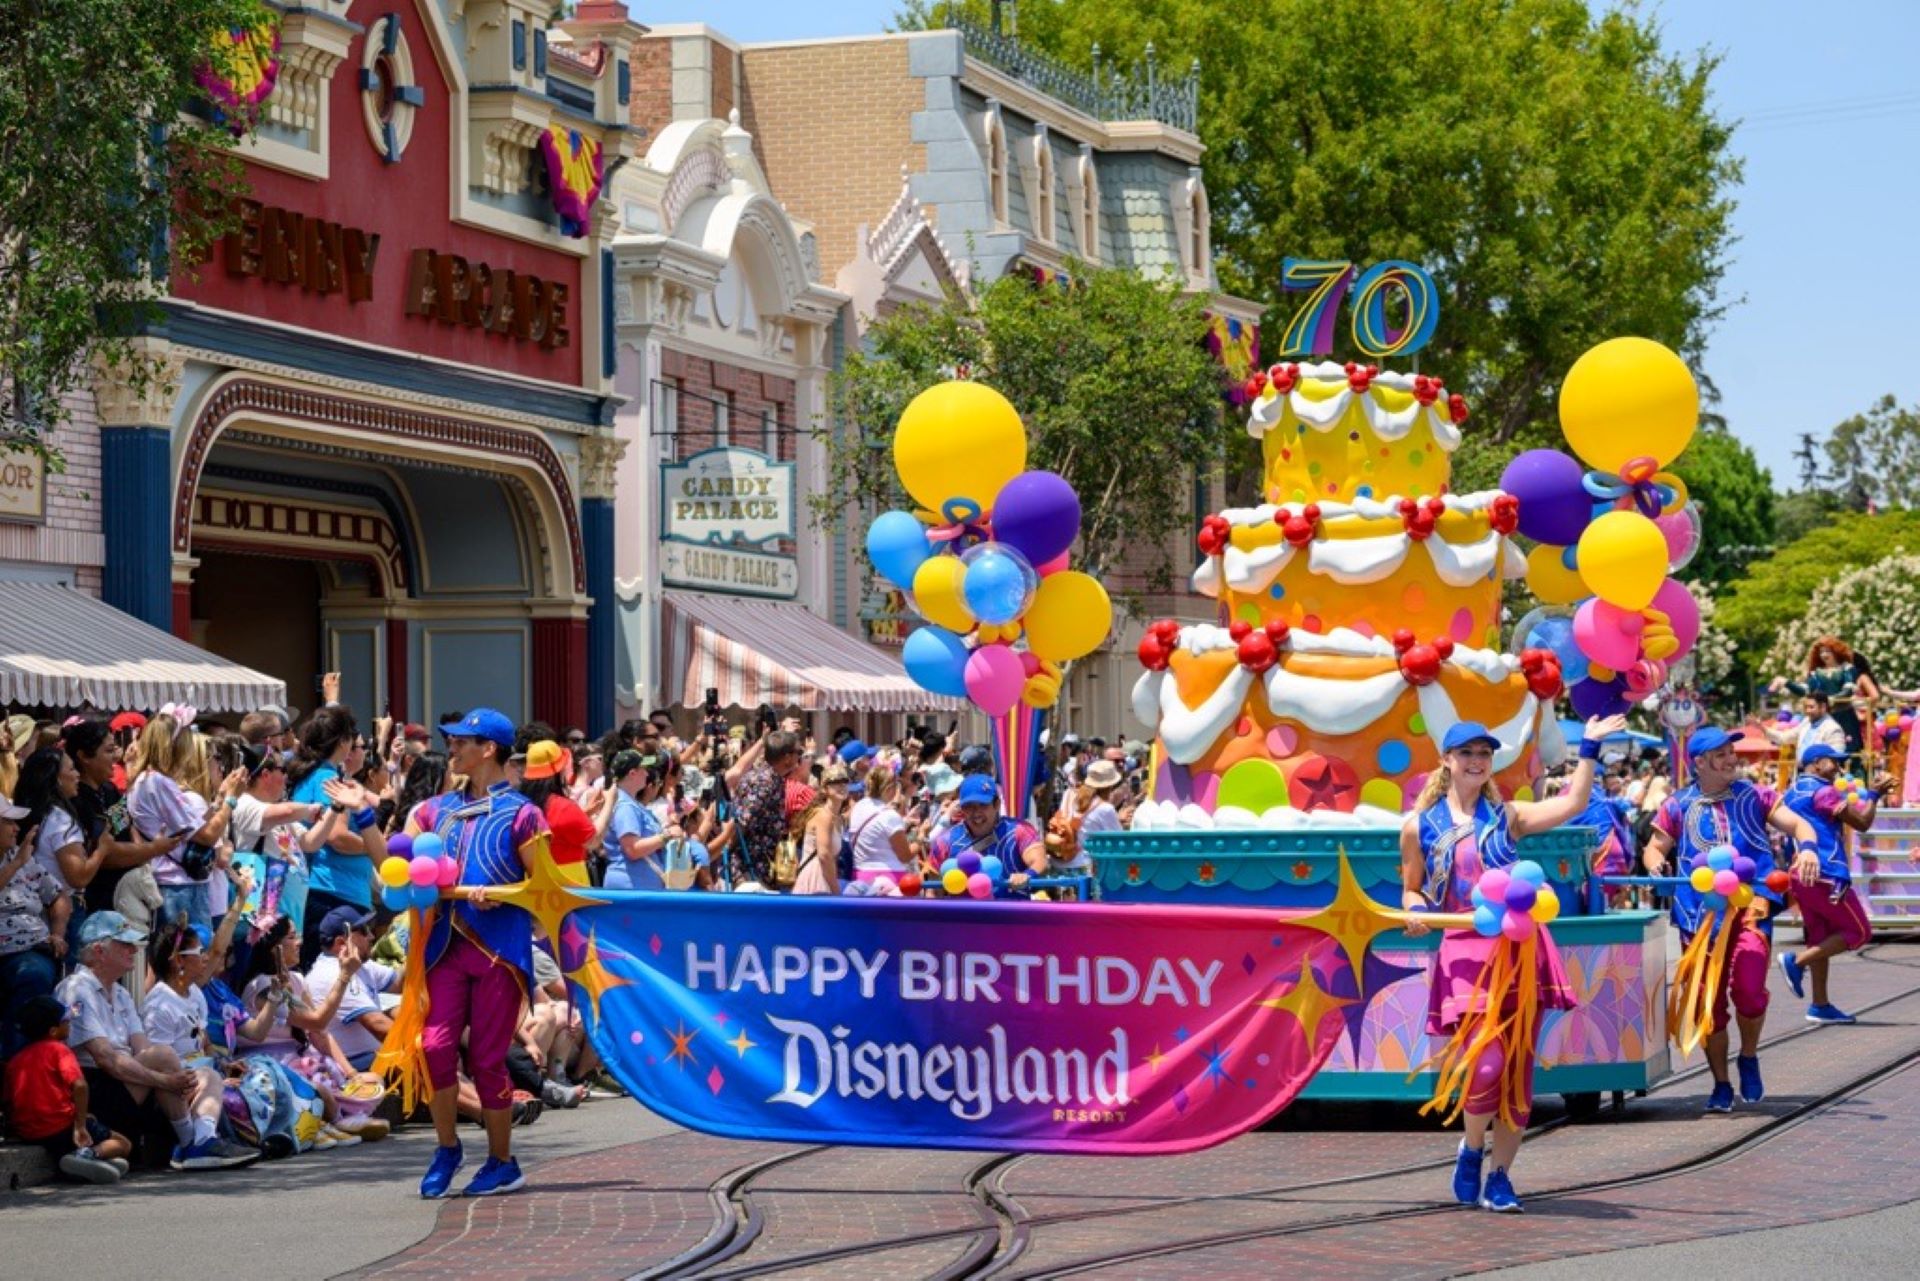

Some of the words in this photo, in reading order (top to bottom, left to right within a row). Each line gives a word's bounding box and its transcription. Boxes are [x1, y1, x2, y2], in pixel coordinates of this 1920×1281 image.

[405, 248, 570, 348] ARCADE
[1280, 256, 1440, 357] 70
[682, 476, 772, 497] CANDY
[676, 500, 778, 520] PALACE
[684, 549, 728, 581] CANDY
[733, 556, 778, 587] PALACE
[526, 889, 562, 912] 70
[1329, 910, 1373, 936] 70
[685, 941, 889, 998] HAPPY
[900, 951, 1224, 1008] BIRTHDAY
[765, 1012, 1132, 1121] Disneyland
[1053, 1108, 1126, 1122] RESORT
